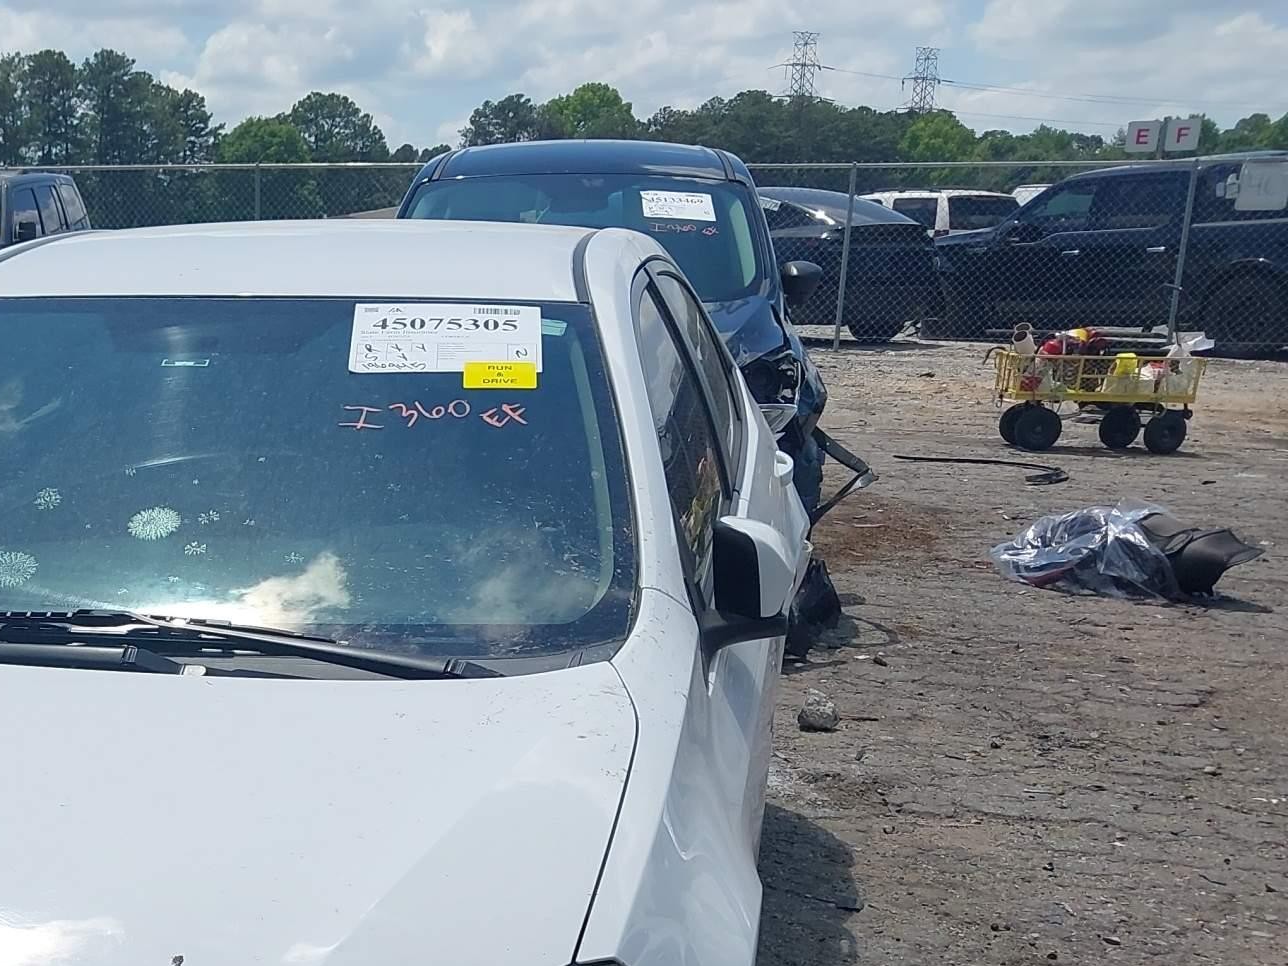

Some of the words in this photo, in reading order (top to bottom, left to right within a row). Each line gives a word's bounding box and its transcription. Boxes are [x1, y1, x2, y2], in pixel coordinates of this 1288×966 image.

[1135, 128, 1150, 145] E
[1176, 127, 1191, 144] F
[372, 317, 518, 331] 45075305
